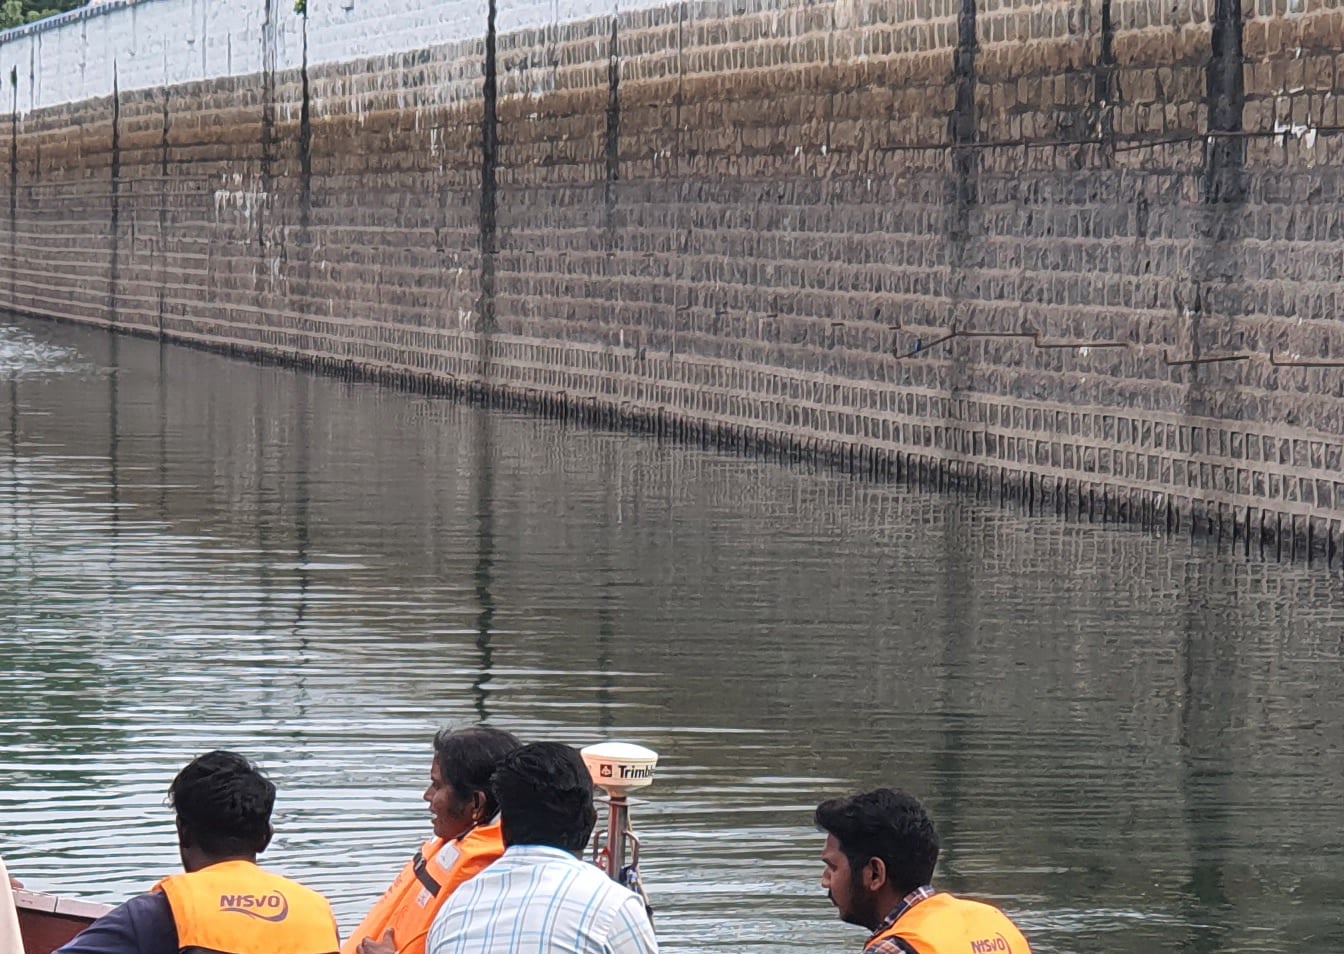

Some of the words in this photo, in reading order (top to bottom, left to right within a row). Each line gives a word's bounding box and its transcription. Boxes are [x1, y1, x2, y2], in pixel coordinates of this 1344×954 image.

[618, 764, 654, 779] Trimb
[220, 895, 281, 908] NISVO
[971, 938, 1006, 953] NISVO
